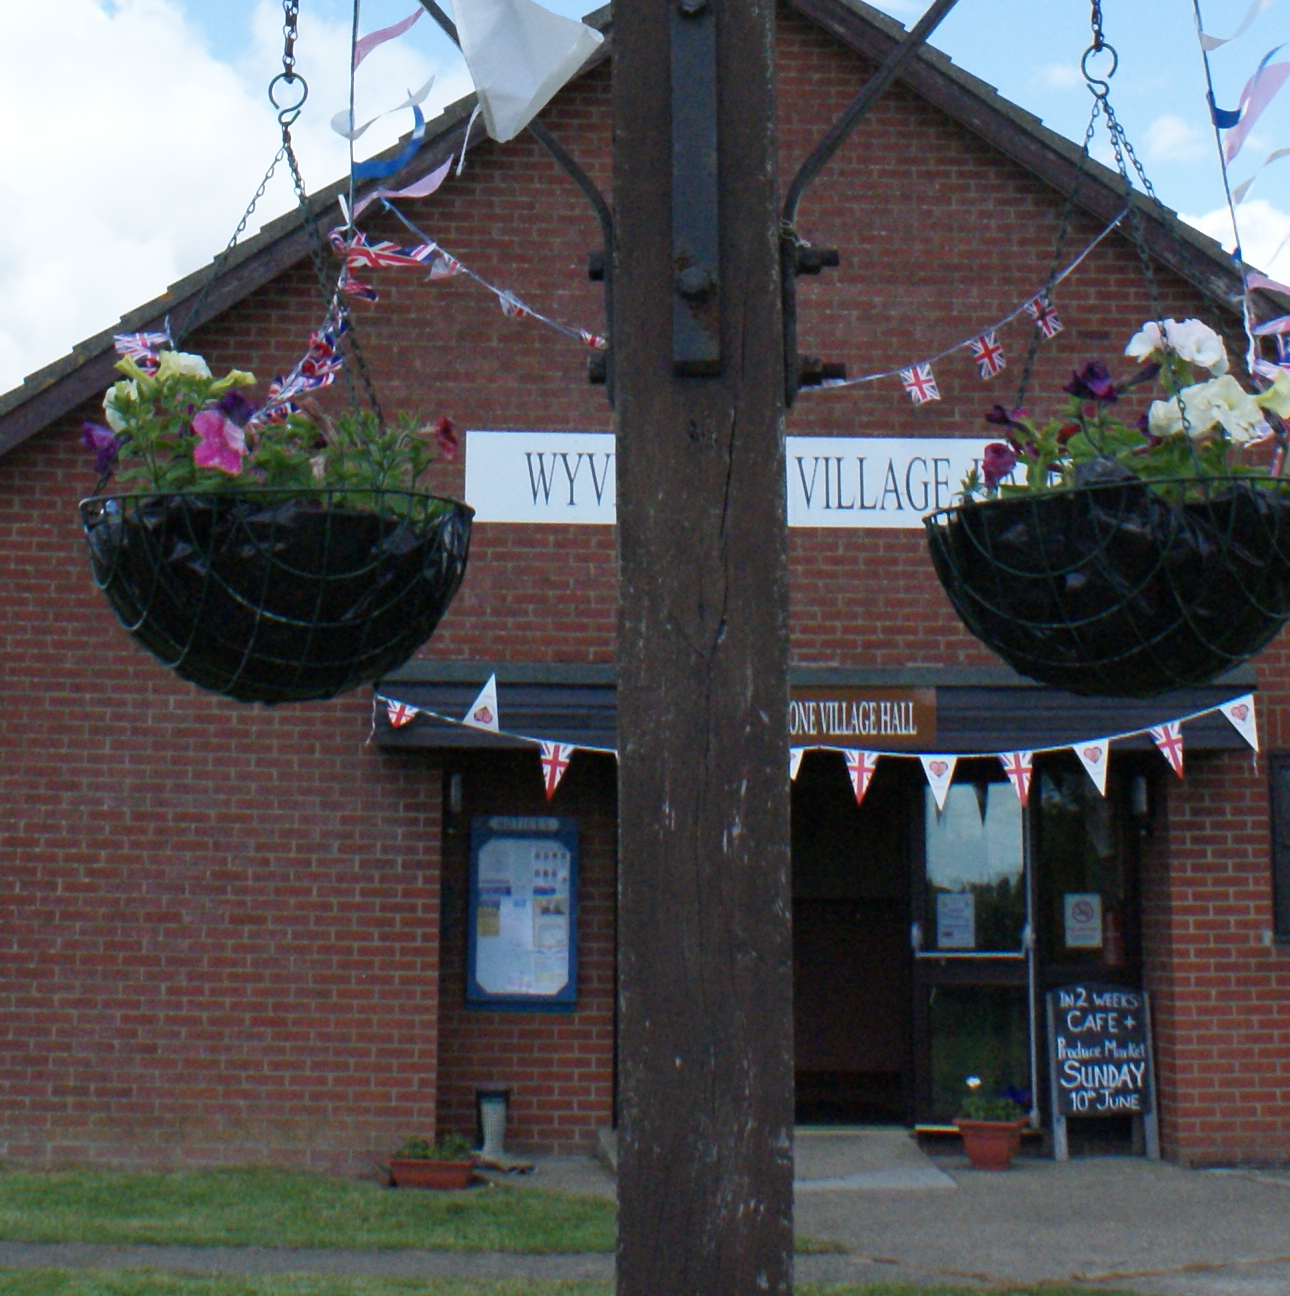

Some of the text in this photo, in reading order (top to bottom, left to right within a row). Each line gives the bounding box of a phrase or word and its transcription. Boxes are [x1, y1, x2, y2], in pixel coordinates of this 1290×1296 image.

[525, 452, 615, 507] WYV
[795, 455, 952, 512] VILLAGE
[819, 700, 877, 735] VILLAGE
[880, 701, 917, 735] HALL
[1059, 990, 1074, 1008] IN
[1076, 987, 1088, 1007] 2
[1067, 1010, 1119, 1033] CAFE
[1057, 1035, 1145, 1059] Produce Market
[1059, 1060, 1145, 1089] SUNDAY
[1096, 1089, 1141, 1111] JUNE
